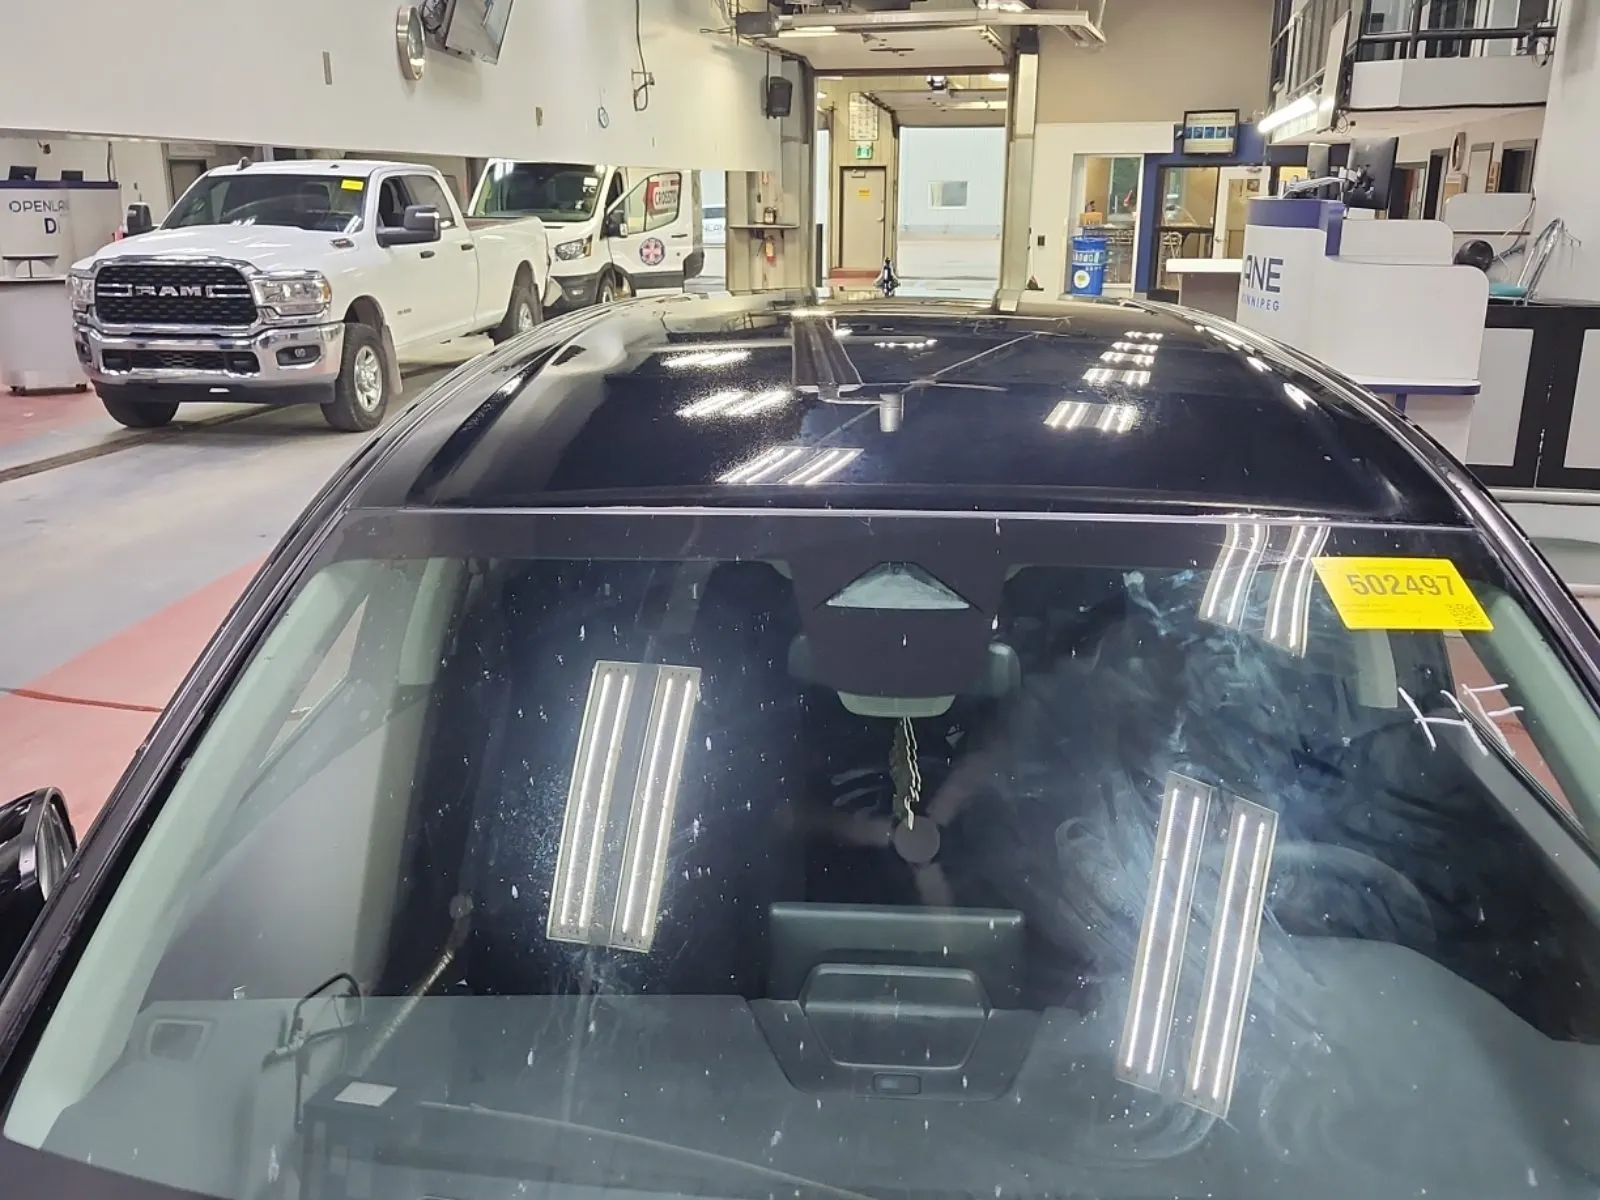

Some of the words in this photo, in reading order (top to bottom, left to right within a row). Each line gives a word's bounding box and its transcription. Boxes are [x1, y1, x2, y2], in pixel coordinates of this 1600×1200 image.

[8, 199, 69, 213] OPENLA
[135, 285, 202, 297] RAM
[1345, 573, 1455, 596] 502497
